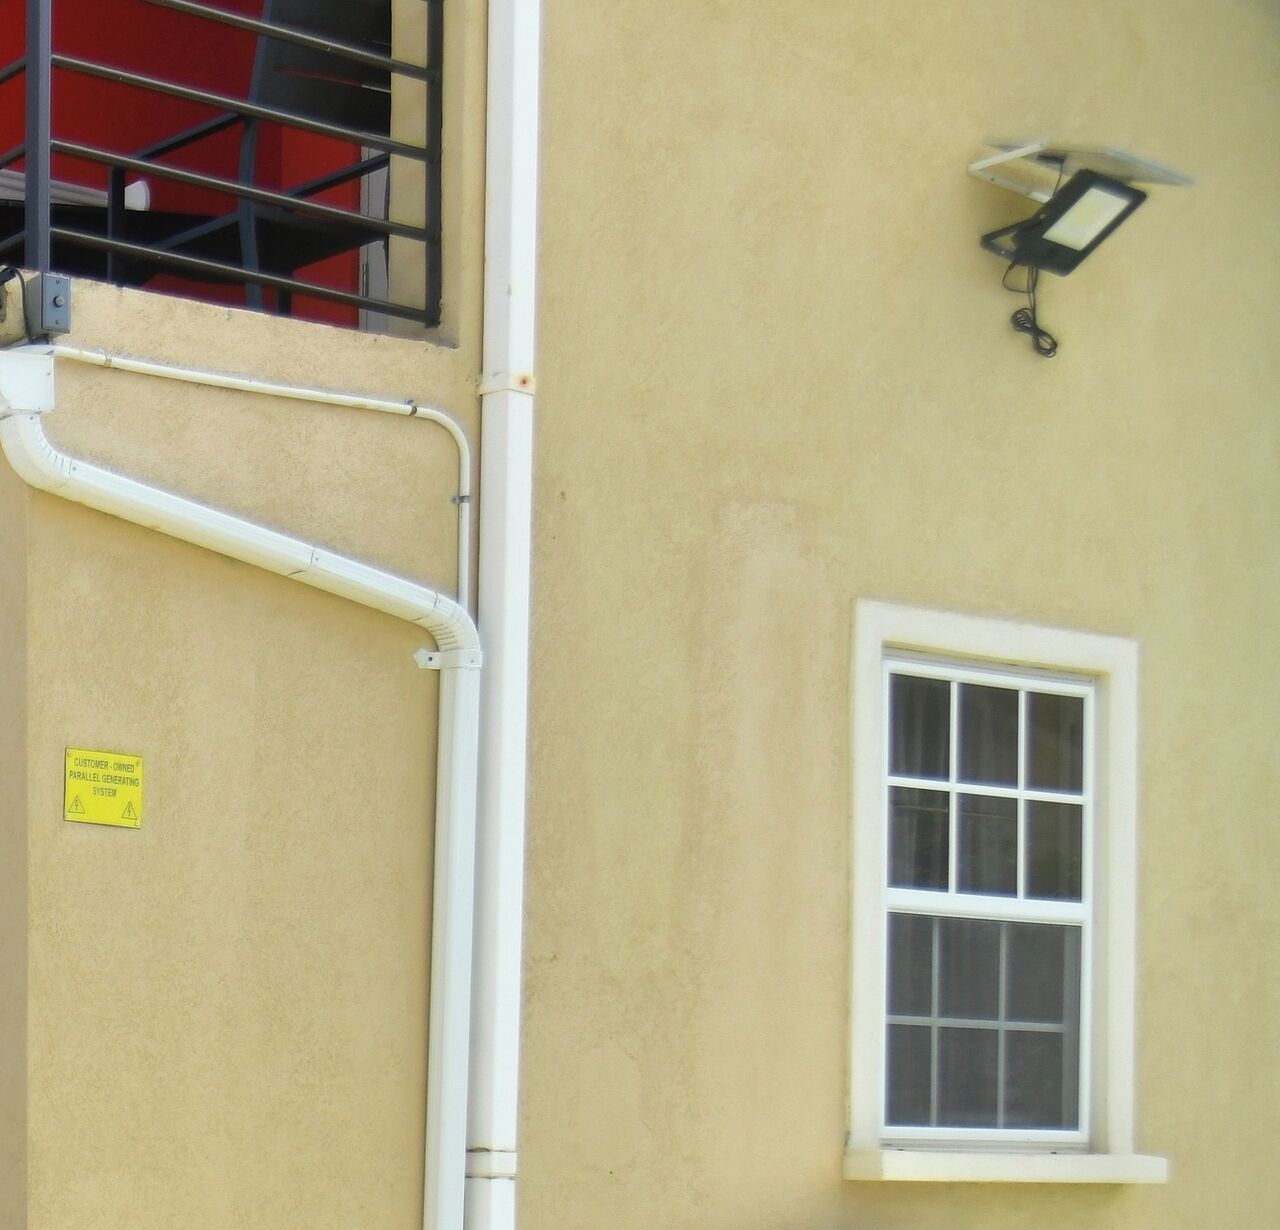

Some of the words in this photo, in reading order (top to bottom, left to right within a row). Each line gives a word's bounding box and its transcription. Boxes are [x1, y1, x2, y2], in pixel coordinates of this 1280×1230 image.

[74, 757, 109, 770] CUSTOMER
[113, 762, 135, 773] OWNED
[69, 770, 101, 782] PARALLEL
[101, 774, 140, 787] GENERATING
[92, 786, 117, 797] SYSTEM
